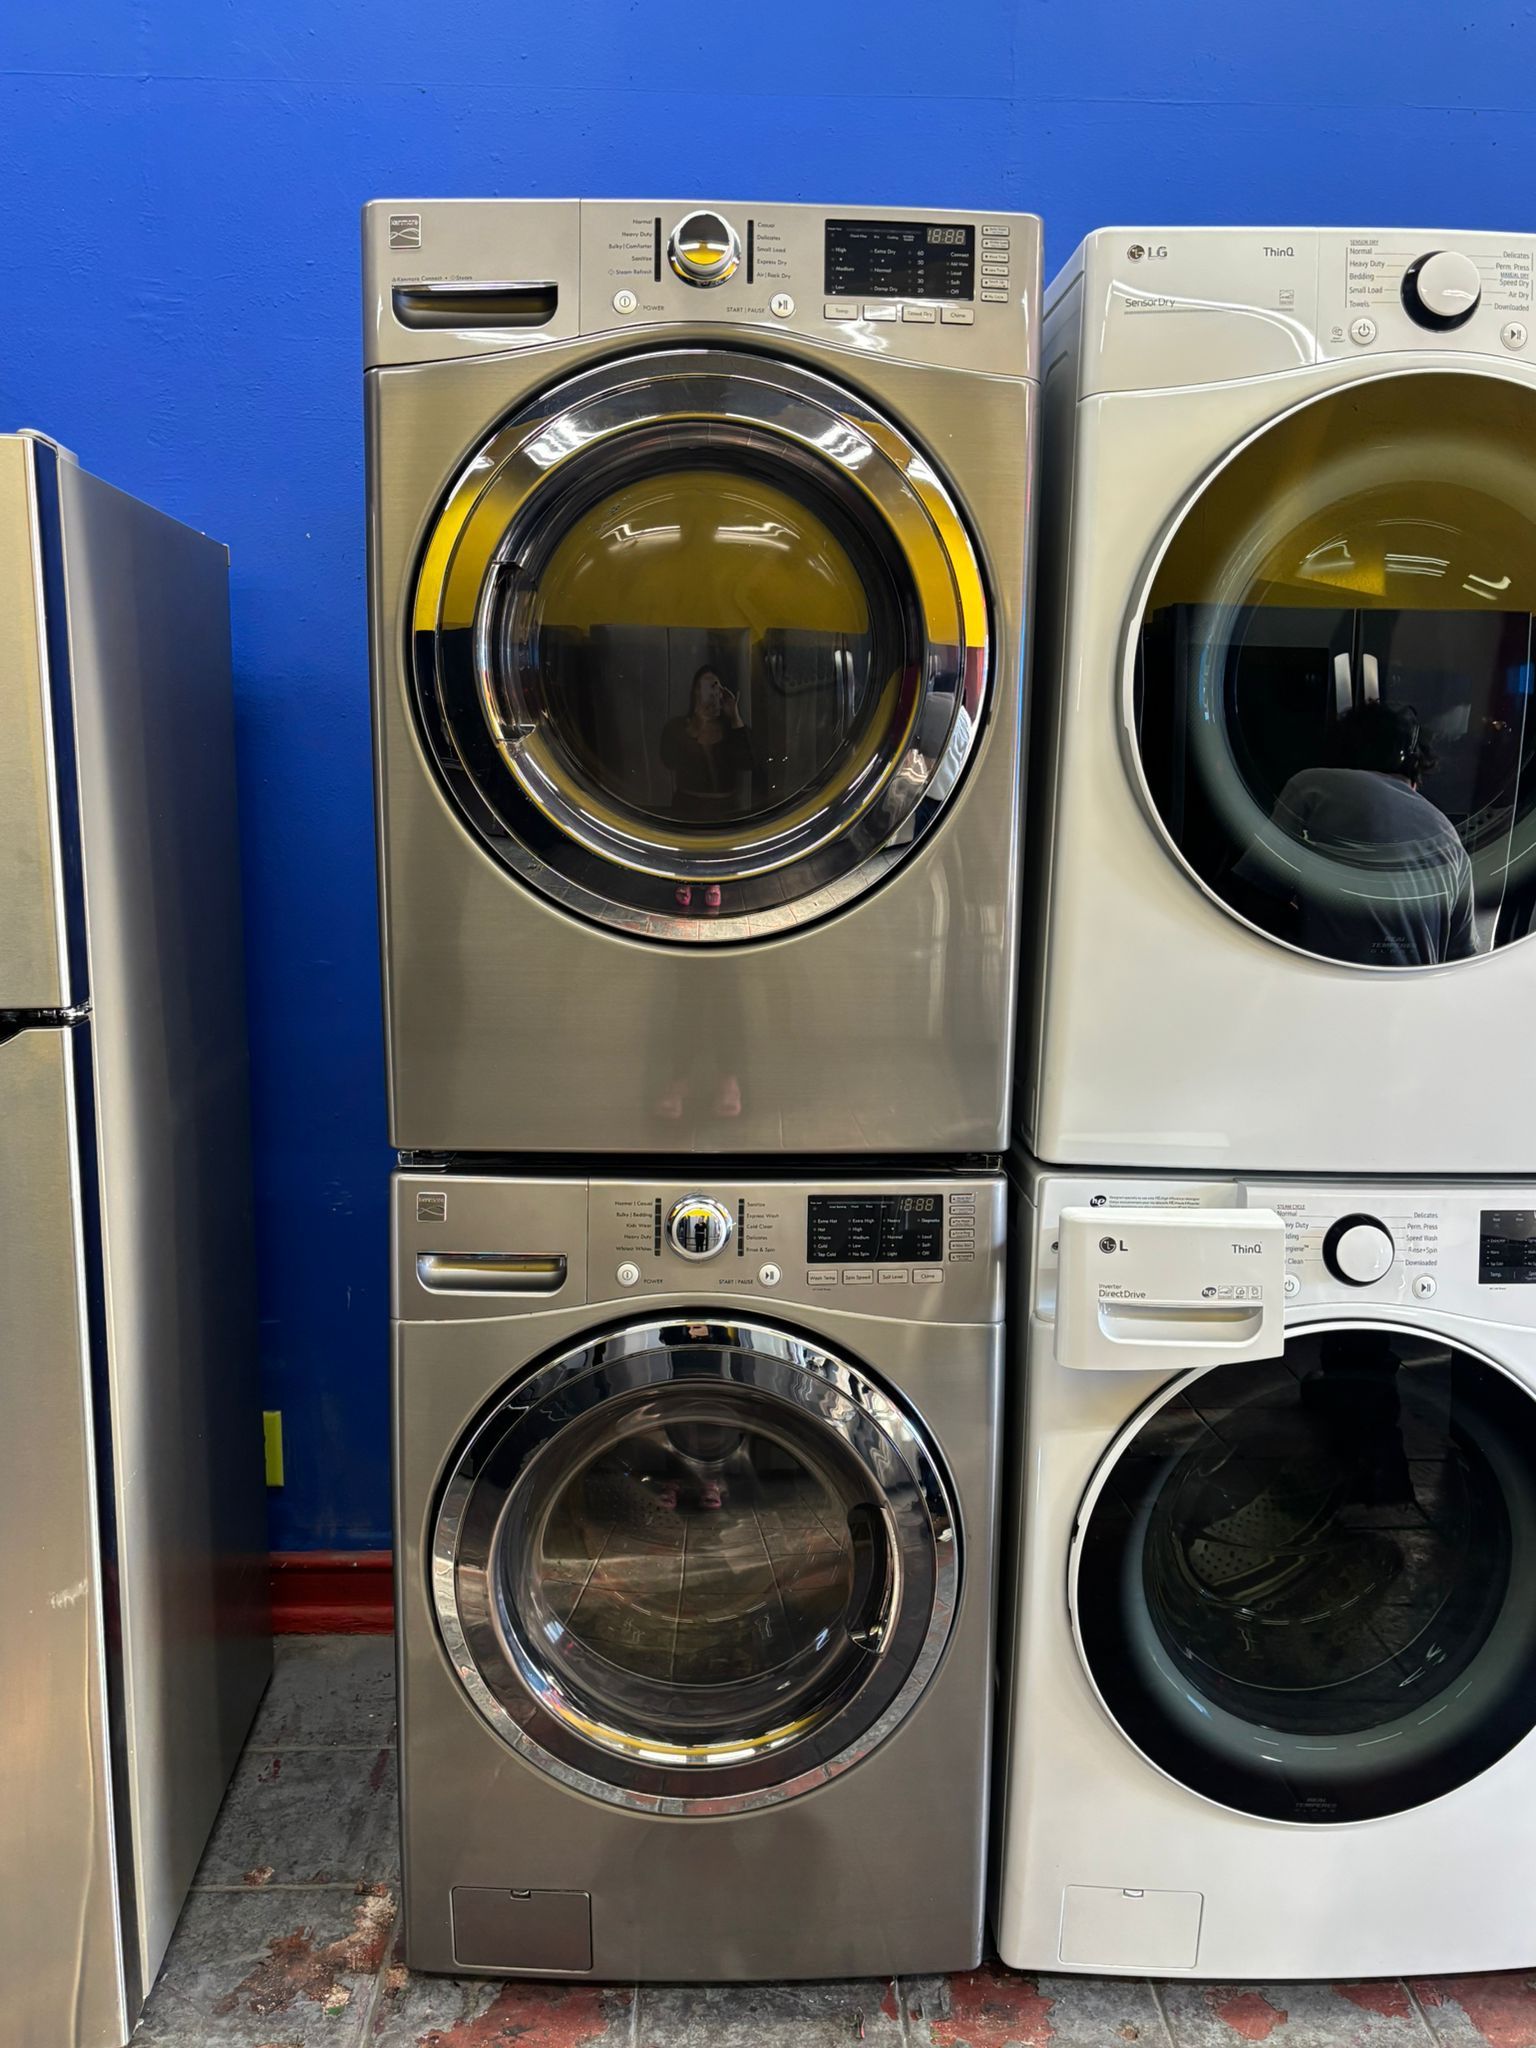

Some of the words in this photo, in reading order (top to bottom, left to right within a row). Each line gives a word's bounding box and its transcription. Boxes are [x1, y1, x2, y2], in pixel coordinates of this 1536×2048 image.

[1148, 246, 1168, 258] LG
[1264, 247, 1294, 257] ThinQ
[1504, 251, 1530, 259] Delicates
[1350, 260, 1368, 268] Heavy
[1370, 260, 1385, 268] Duty
[1350, 272, 1374, 281] Bedding
[1519, 280, 1530, 288] Dry
[1518, 292, 1530, 300] Dry
[1494, 303, 1530, 311] Downloaded
[1232, 1244, 1262, 1254] ThinQ
